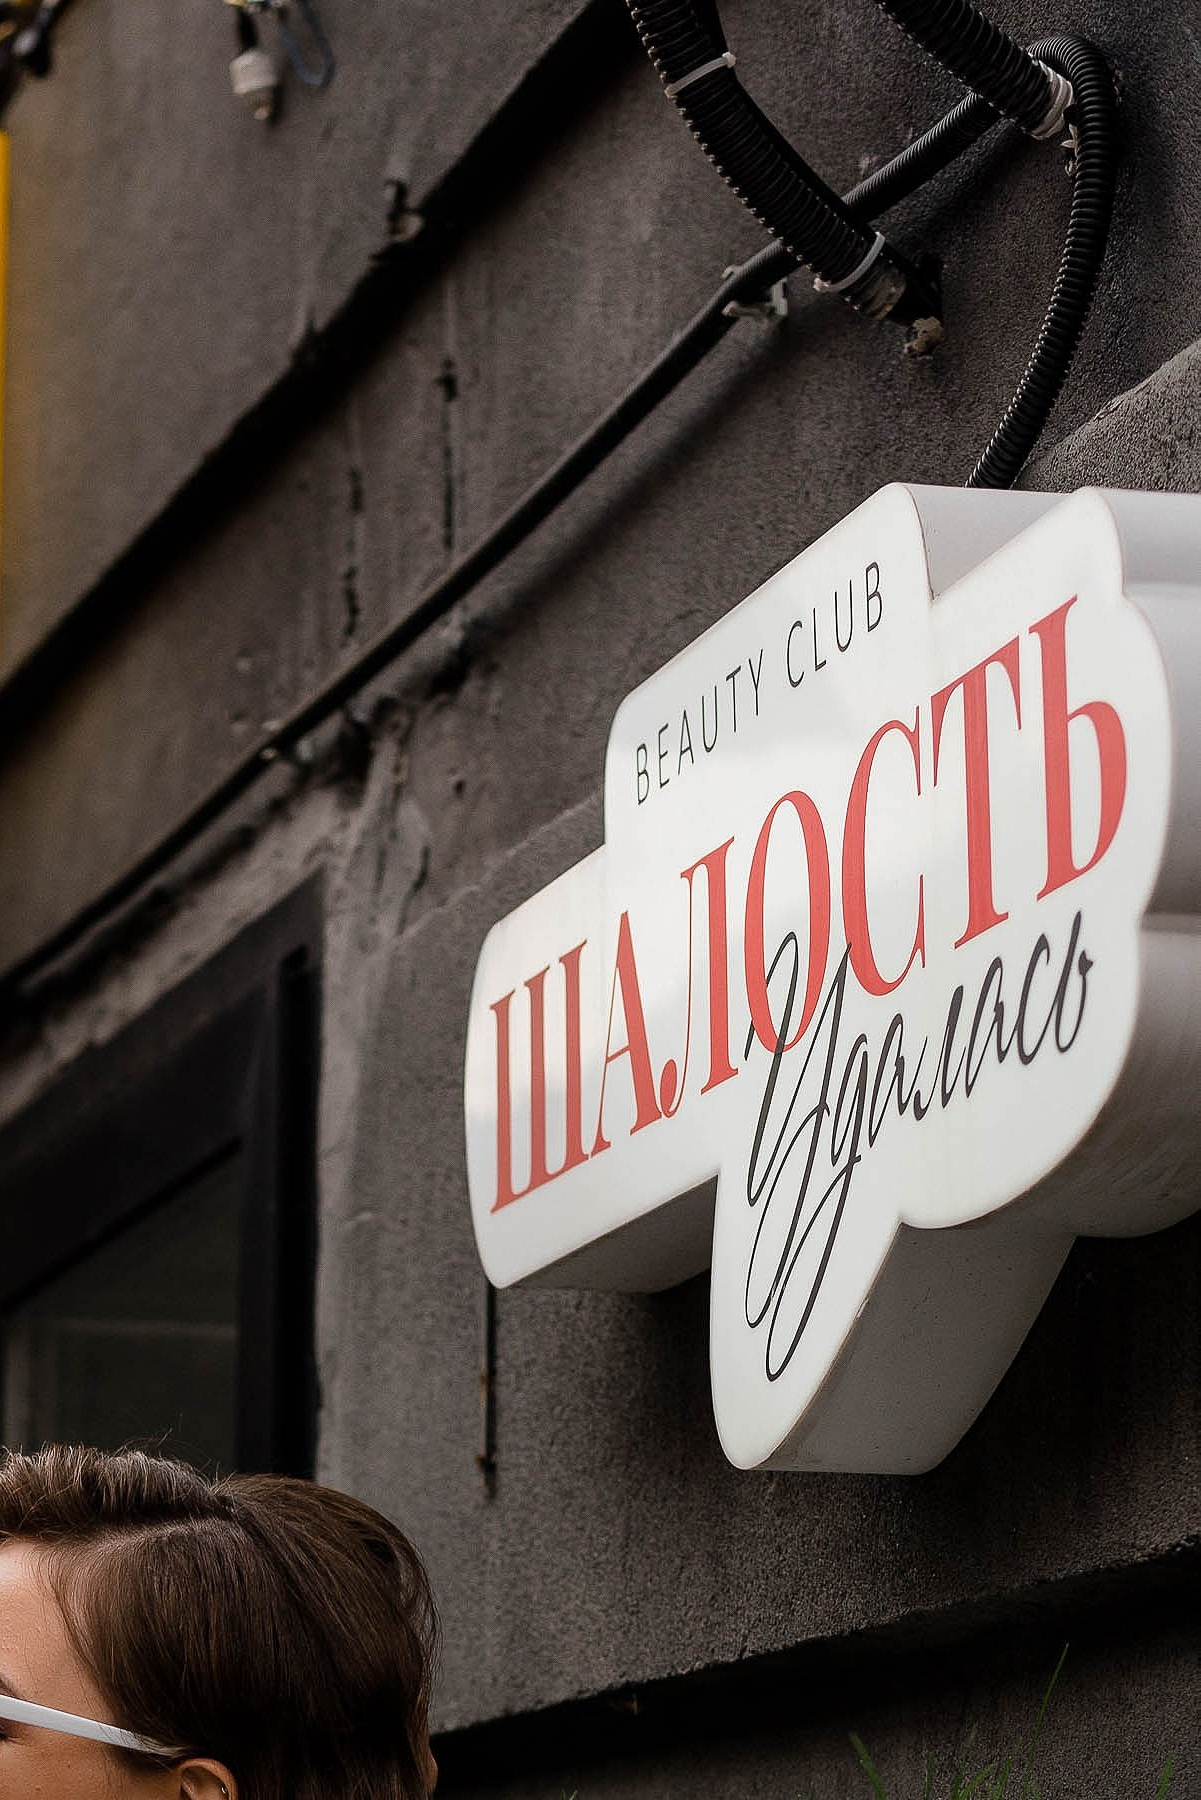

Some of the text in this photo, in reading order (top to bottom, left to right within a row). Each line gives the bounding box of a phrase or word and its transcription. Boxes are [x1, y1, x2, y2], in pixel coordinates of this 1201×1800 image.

[636, 560, 884, 806] BEAUTY CLUB
[490, 595, 1128, 1213] ШАЛОСТЬ
